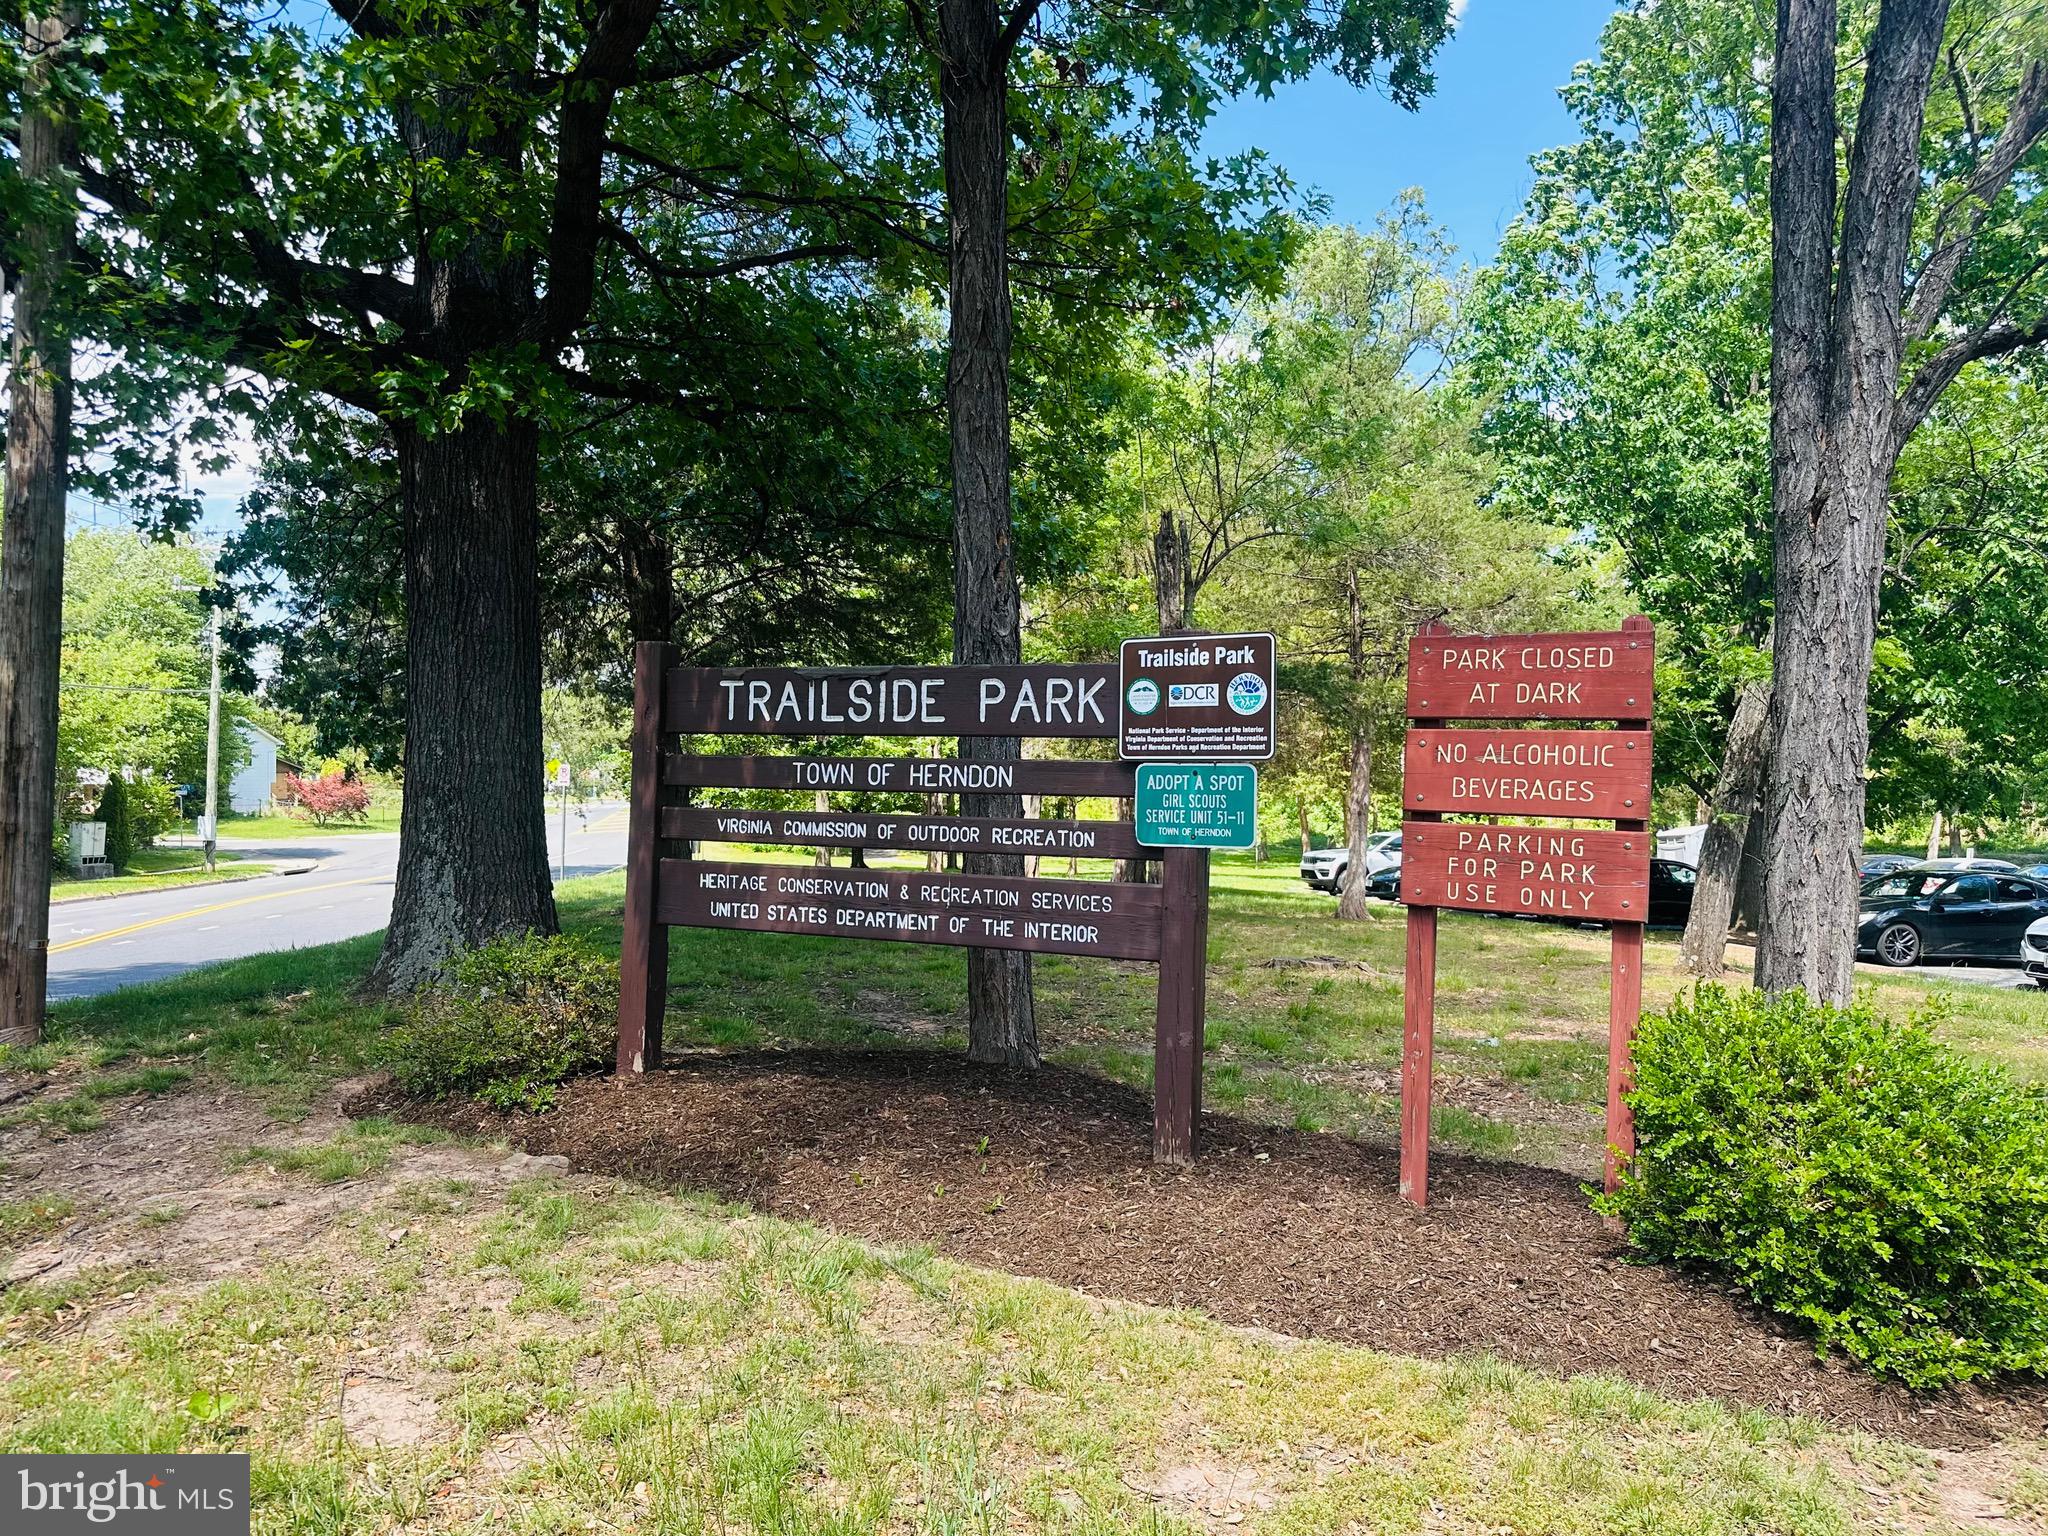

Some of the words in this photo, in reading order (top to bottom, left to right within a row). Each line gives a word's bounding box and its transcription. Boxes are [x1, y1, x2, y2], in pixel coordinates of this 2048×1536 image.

[1138, 647, 1210, 668] Trailside
[1215, 645, 1255, 665] Park
[1443, 648, 1506, 670] PARK
[1521, 647, 1614, 669] CLOSED
[720, 679, 946, 723] TRAILSIDE
[979, 677, 1106, 724] PARK
[1183, 685, 1216, 700] DCR
[1469, 683, 1500, 704] AT
[1516, 682, 1582, 704] DARK
[1190, 726, 1223, 735] Department
[1232, 744, 1266, 752] Department
[1437, 743, 1467, 764] NO
[1481, 743, 1615, 767] ALCOHOLIC
[793, 762, 854, 785] TOWN
[867, 763, 896, 786] OF
[910, 763, 1013, 788] HERNDON
[1146, 774, 1190, 791] ADOPT
[1194, 775, 1204, 791] A
[1210, 775, 1245, 791] SPOT
[1452, 776, 1595, 802] BEVERAGES
[1162, 793, 1185, 808] GIRL
[1188, 794, 1227, 809] SCOUTS
[1145, 809, 1186, 823] SERVICE
[1190, 810, 1212, 824] UNIT
[1217, 811, 1245, 825] 51-11
[717, 818, 773, 836] VIRGINIA
[783, 819, 867, 838] COMMISSION
[877, 823, 897, 840] OF
[908, 824, 980, 843] OUTDOOR
[991, 827, 1095, 848] RECREATION
[1158, 826, 1179, 836] TOWN
[1182, 827, 1192, 837] OF
[1194, 828, 1232, 838] HERNDON
[1458, 831, 1585, 857] PARKING
[1448, 856, 1497, 878] FOR
[1520, 860, 1596, 885] PARK
[700, 873, 768, 892] HERITAGE
[778, 877, 889, 898] CONSERVATION
[900, 884, 909, 900] &
[920, 885, 1019, 907] RECREATION
[1031, 892, 1112, 912] SERVICES
[1447, 881, 1497, 904] USE
[1520, 886, 1595, 910] ONLY
[710, 901, 759, 919] UNITED
[767, 905, 827, 924] STATES
[836, 909, 939, 931] DEPARTMENT
[949, 916, 970, 934] OF
[982, 918, 1014, 937] THE
[1024, 922, 1098, 943] INTERIOR
